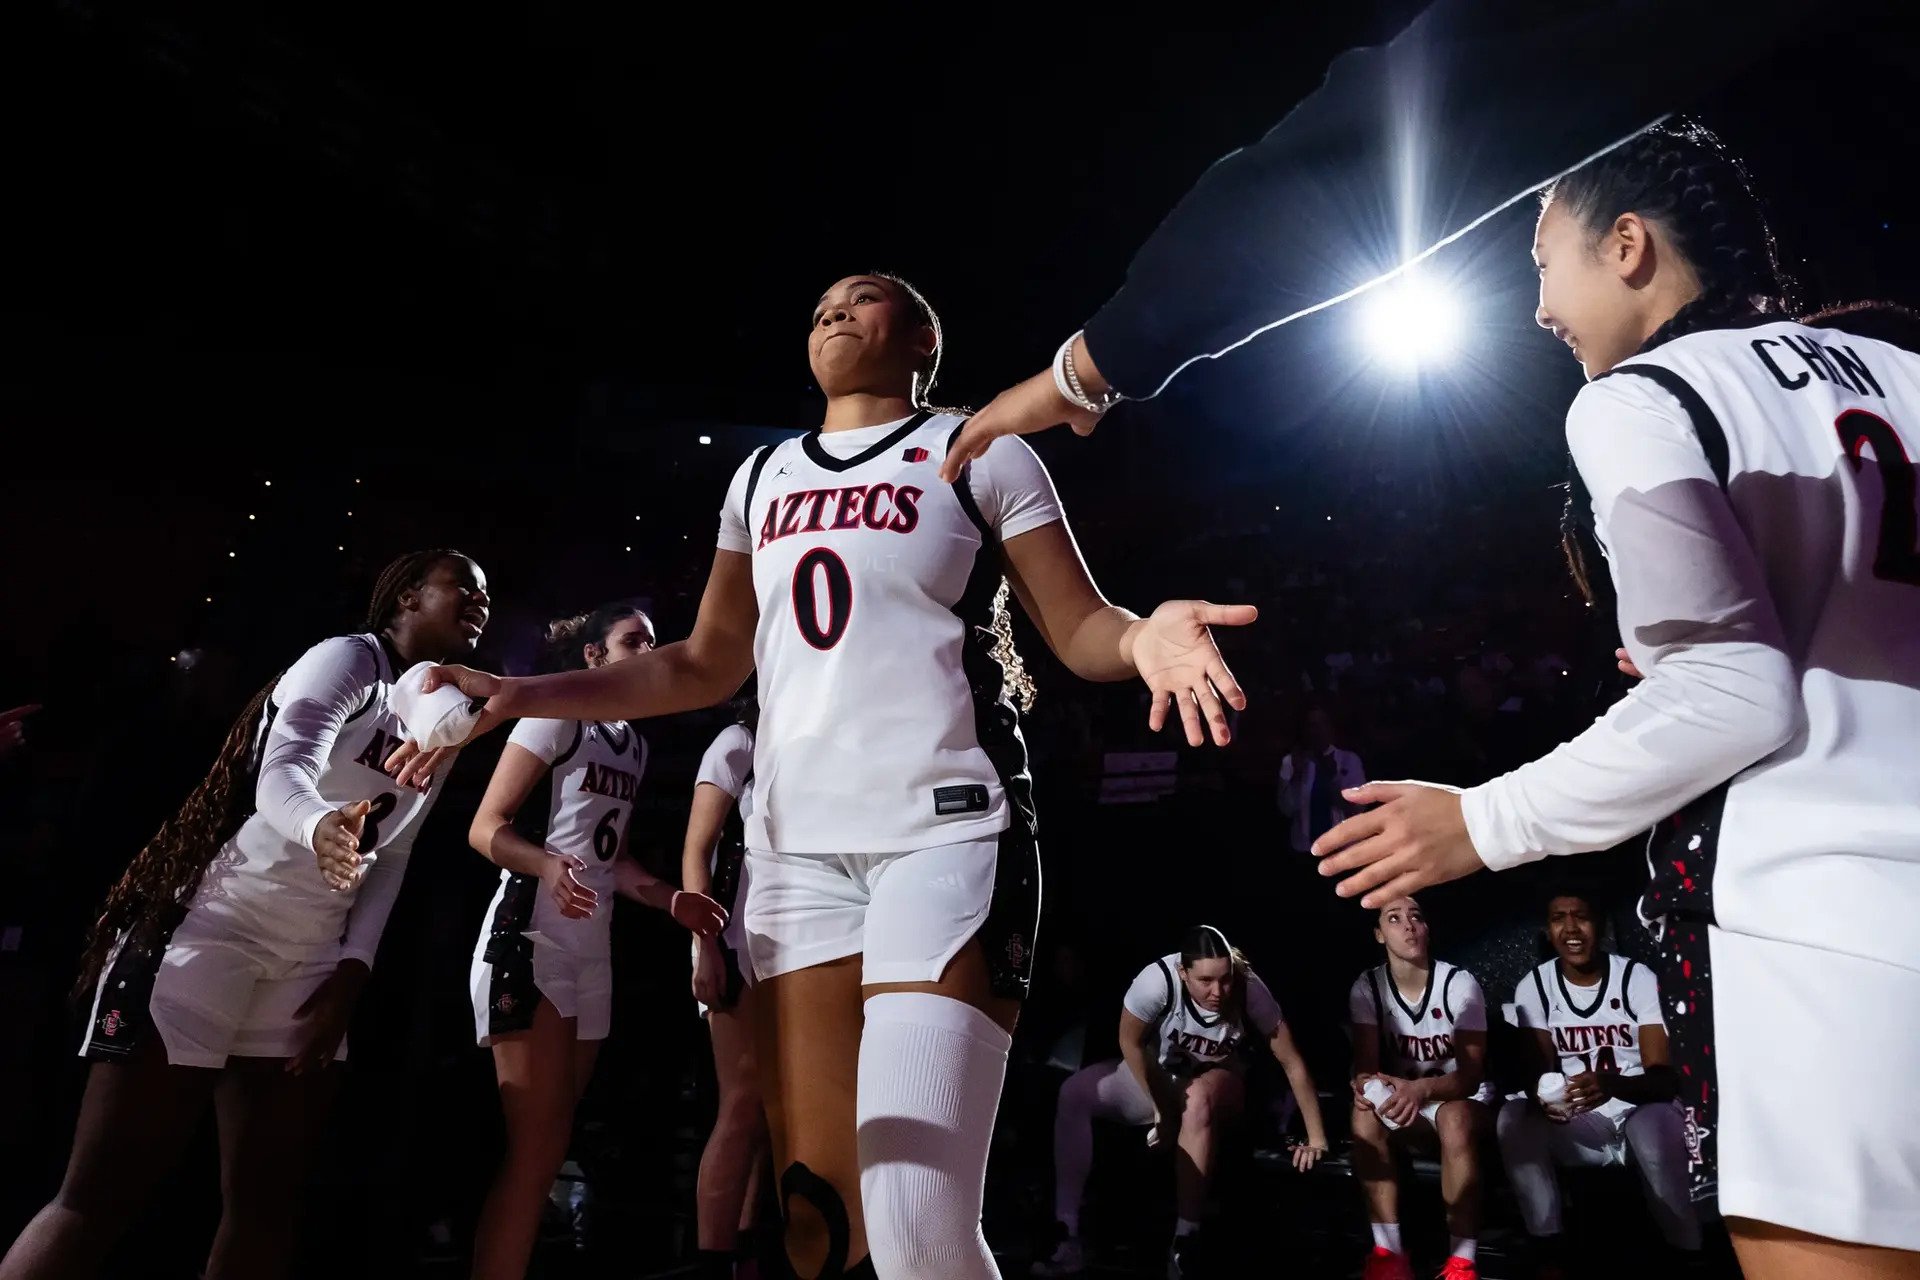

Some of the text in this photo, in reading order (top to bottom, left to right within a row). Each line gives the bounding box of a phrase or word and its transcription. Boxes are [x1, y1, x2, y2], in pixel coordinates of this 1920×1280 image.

[757, 482, 924, 551] AZTECS
[792, 547, 852, 650] 0
[594, 808, 620, 862] 6
[1555, 1024, 1633, 1052] AZTECS
